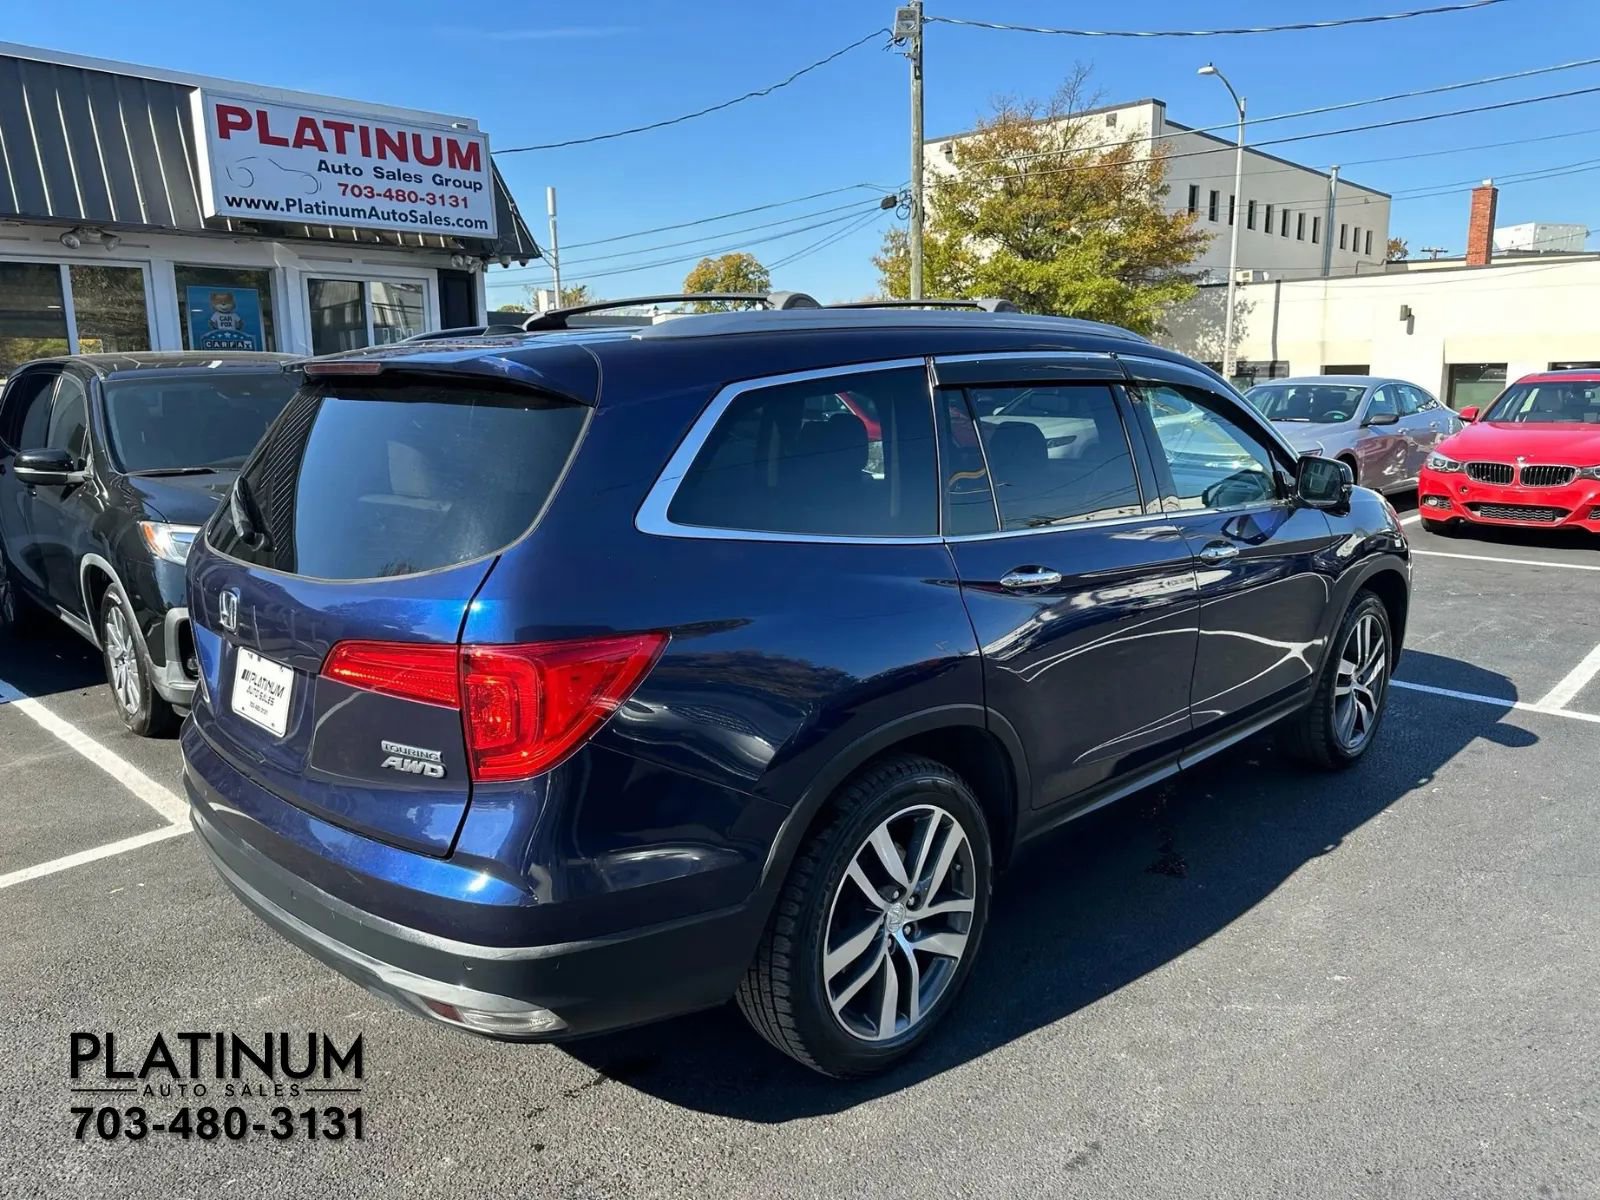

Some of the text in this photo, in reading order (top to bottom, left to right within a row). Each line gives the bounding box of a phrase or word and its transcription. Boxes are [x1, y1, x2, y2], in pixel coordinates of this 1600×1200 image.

[215, 103, 482, 173] PLATINUM
[317, 159, 483, 192] Auto Sales Group
[337, 182, 469, 209] 703-480-3131
[224, 195, 489, 230] www.PlatinumAutoSales.com
[205, 341, 252, 349] CARFAX
[249, 671, 285, 699] PLATINUM
[382, 742, 439, 760] TOURING
[381, 756, 445, 778] AWD
